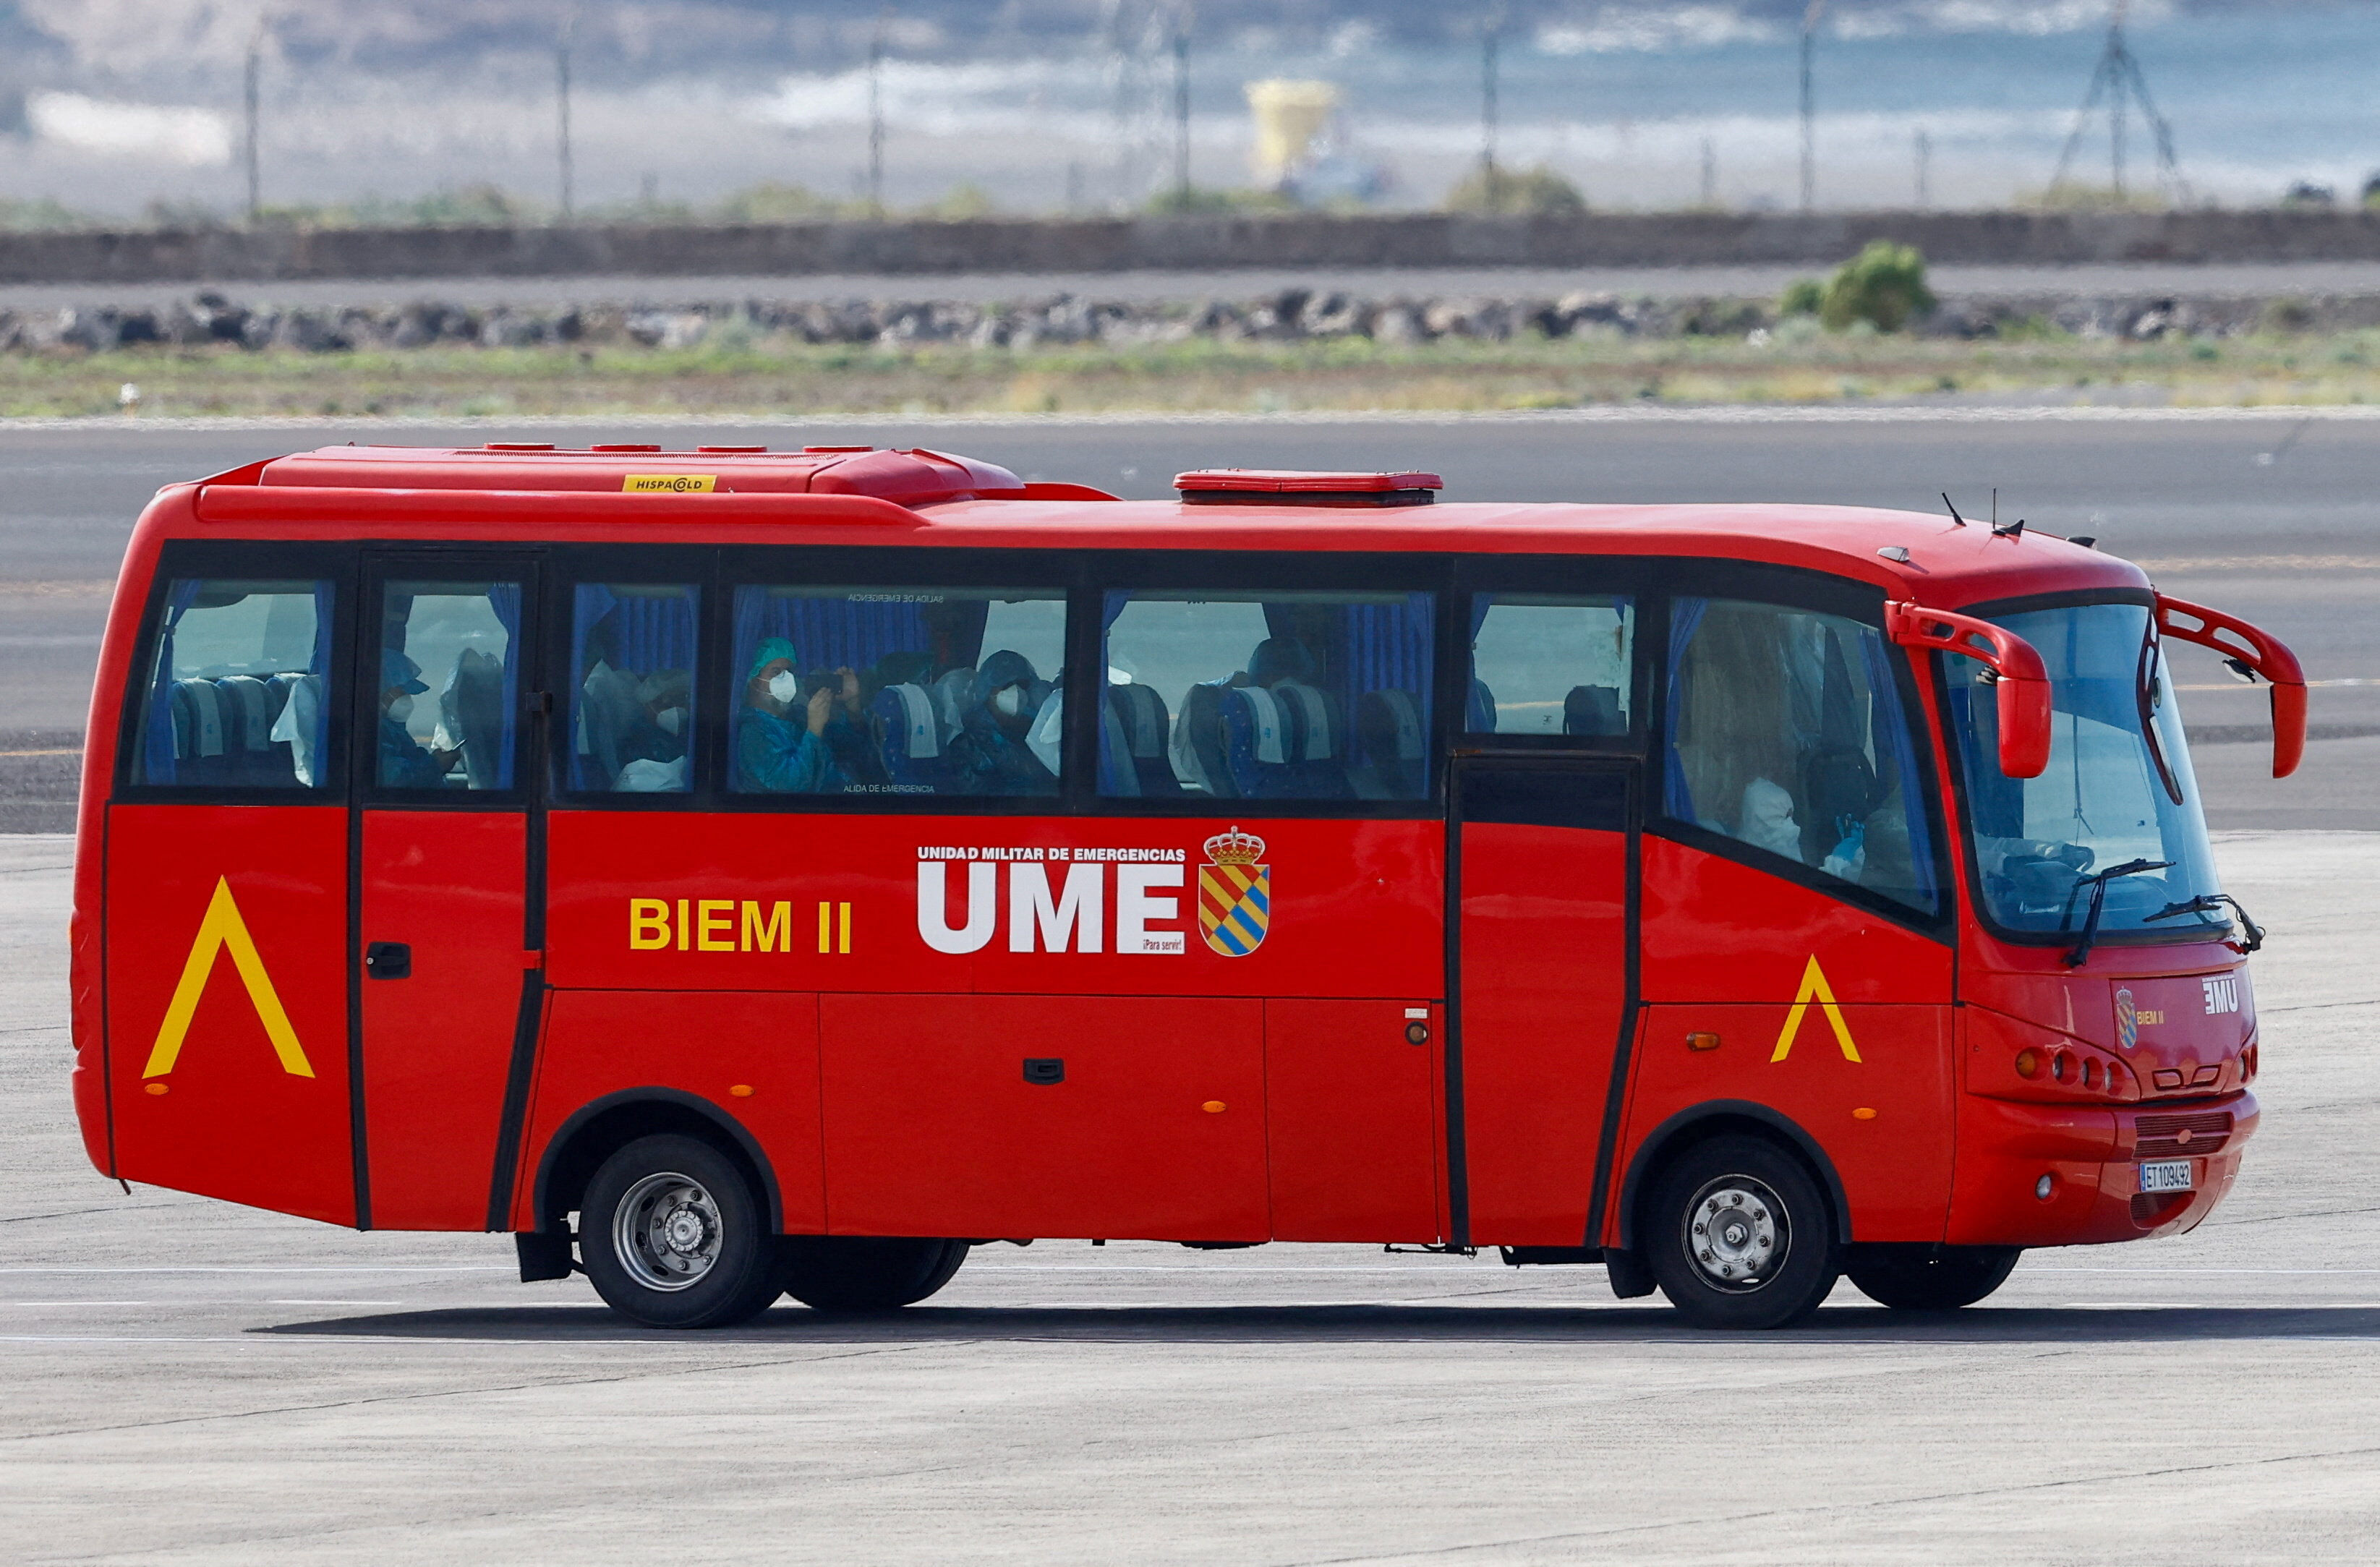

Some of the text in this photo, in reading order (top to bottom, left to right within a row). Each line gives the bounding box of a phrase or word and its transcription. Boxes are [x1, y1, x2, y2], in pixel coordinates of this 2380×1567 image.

[636, 477, 702, 492] HISPACOLD
[882, 785, 934, 793] EMERGENCIA
[918, 847, 1185, 862] UNIDAD MILITAR DE EMERGENCIAS
[917, 861, 1185, 955] UME
[630, 898, 851, 954] BIEM II
[2136, 1010, 2164, 1025] BIEM II
